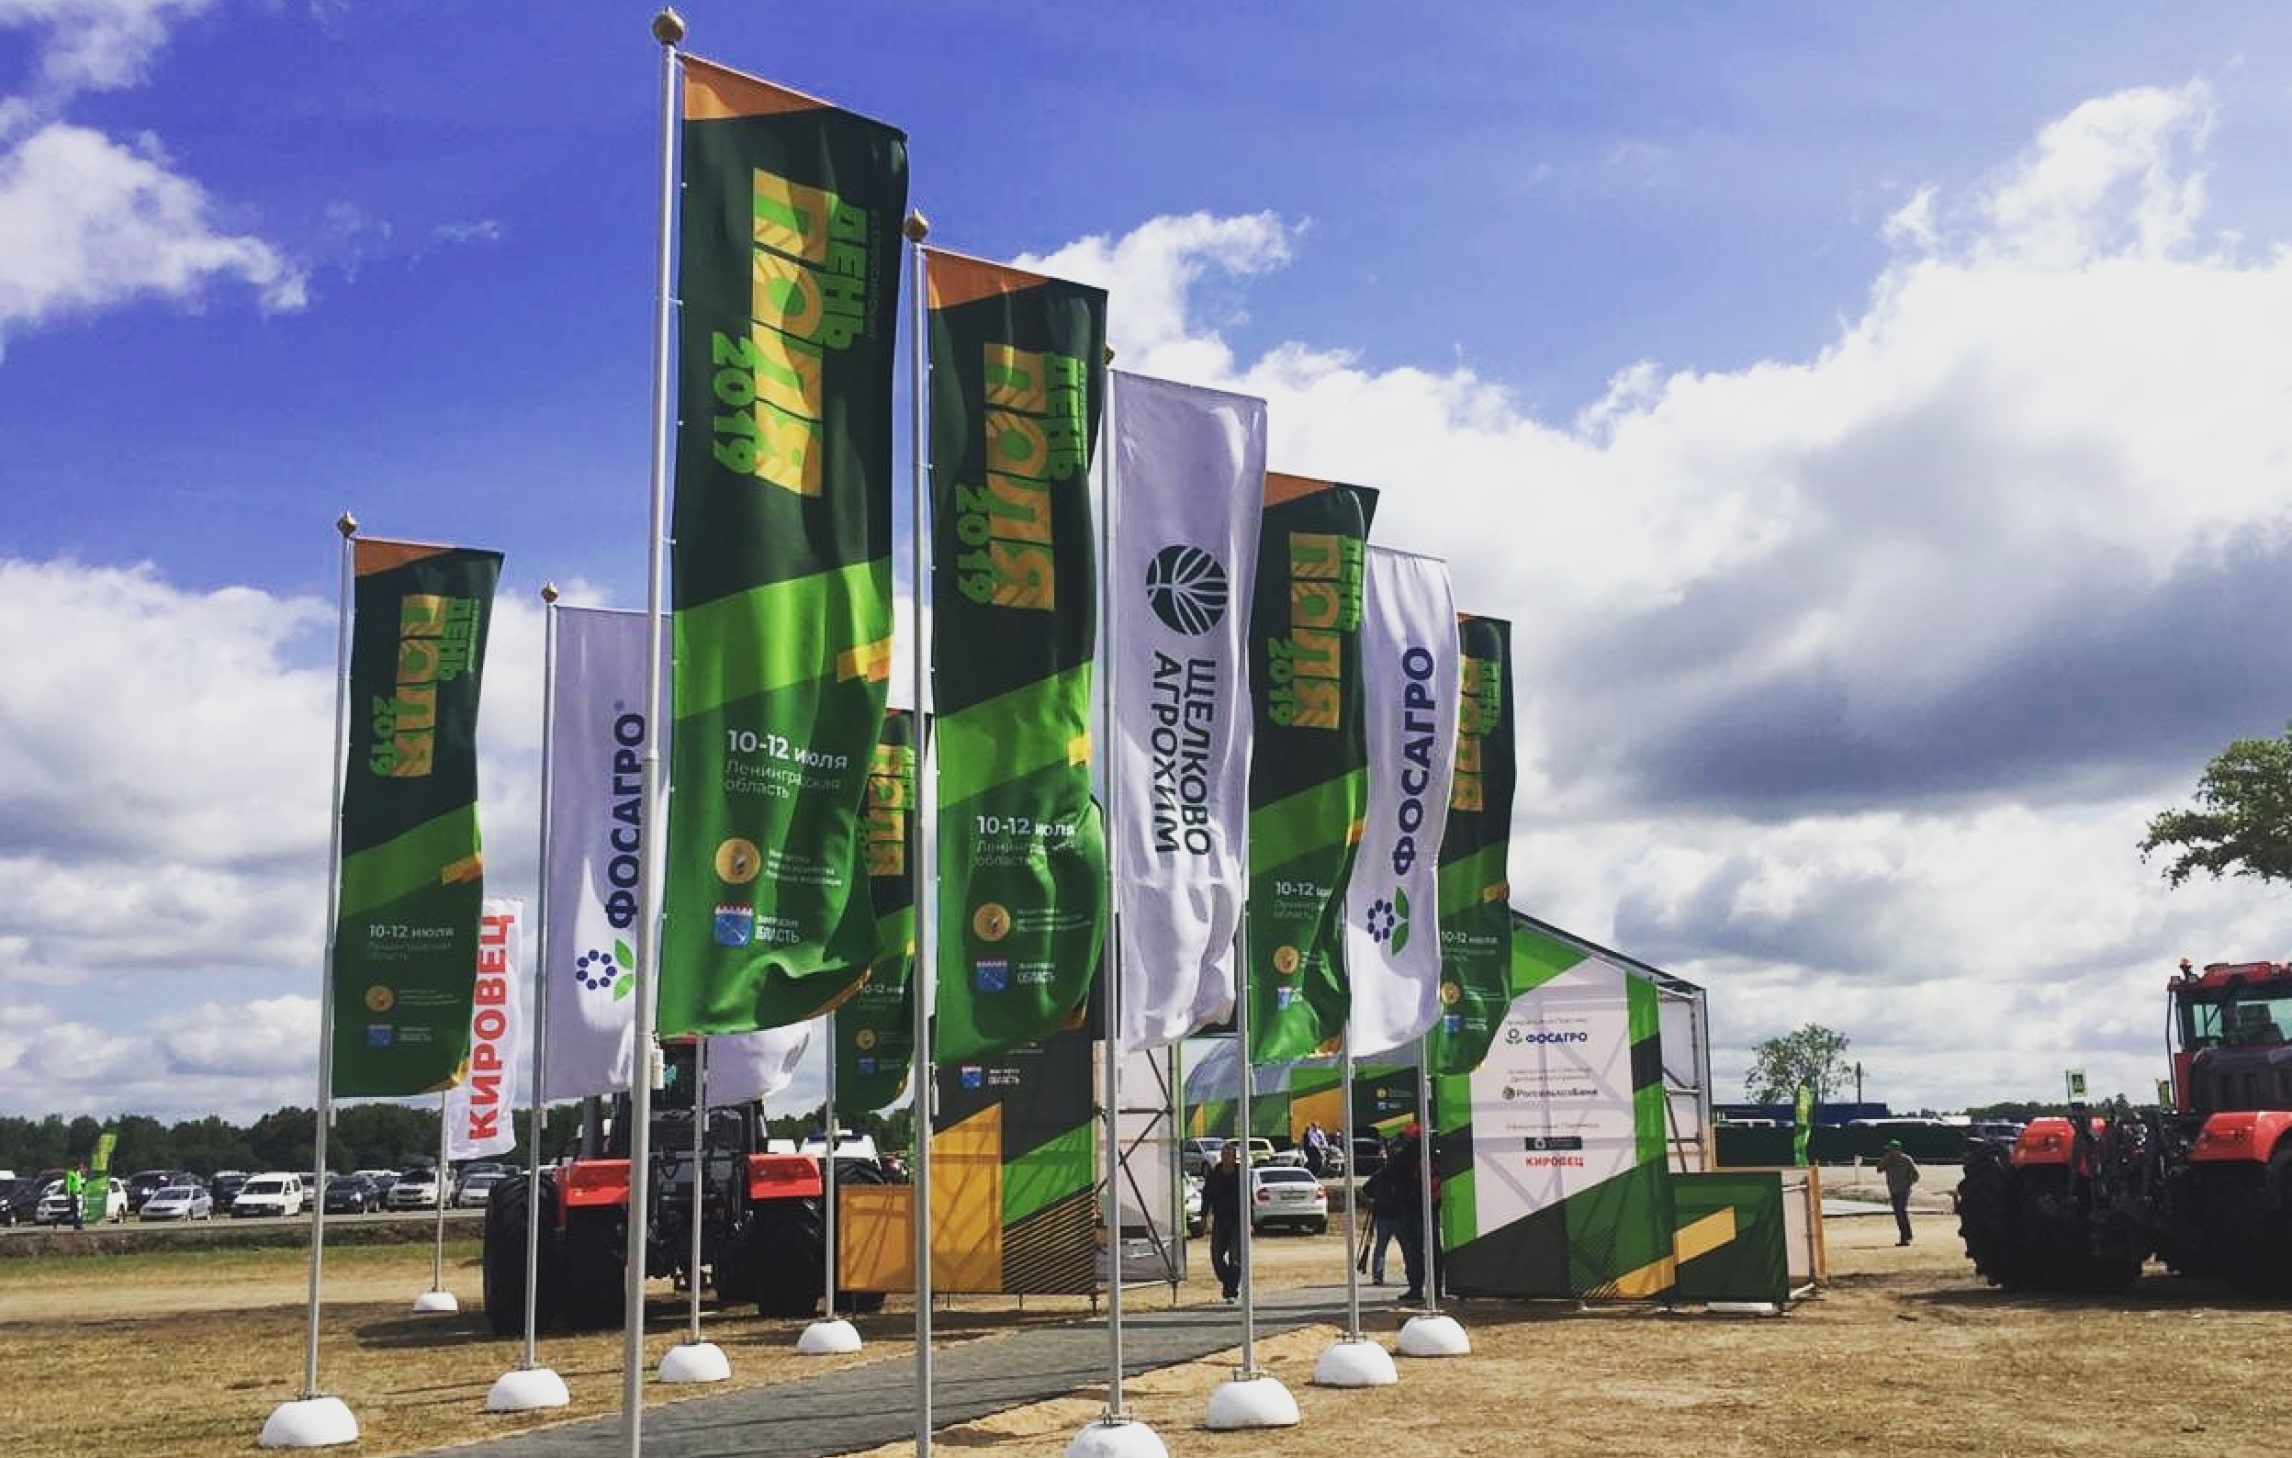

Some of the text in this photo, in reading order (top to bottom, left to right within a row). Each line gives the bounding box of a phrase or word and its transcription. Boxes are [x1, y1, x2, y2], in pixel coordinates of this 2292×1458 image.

[753, 167, 829, 497] ПОЛЯ
[823, 193, 867, 352] ДЕНЬ
[712, 331, 757, 474] 2019
[1045, 353, 1081, 480] ДЕНЬ
[956, 483, 996, 604] 2019
[984, 343, 1055, 610] ПОЛЯ
[391, 594, 446, 777] ПОЛЯ
[440, 597, 474, 680] ДЕНЬ
[1267, 637, 1293, 727] 2019
[1290, 532, 1340, 728] ПОЛЯ
[368, 695, 397, 778] 2019
[729, 730, 848, 769] 10-12 июля
[1151, 651, 1182, 854] АГРОХИМ
[1181, 659, 1216, 856] ЩЕЛКОВО
[1393, 647, 1435, 875] ФОСАГРО
[606, 713, 645, 929] ФОСАГРО
[976, 815, 1031, 835] 10-12
[1275, 881, 1314, 896] 10-12
[370, 924, 408, 938] 10-12
[469, 915, 514, 1140] КИРОВЕЦ
[1525, 1032, 1588, 1044] ФОСАГРО
[1525, 1156, 1584, 1168] КИРОВЕЦ
